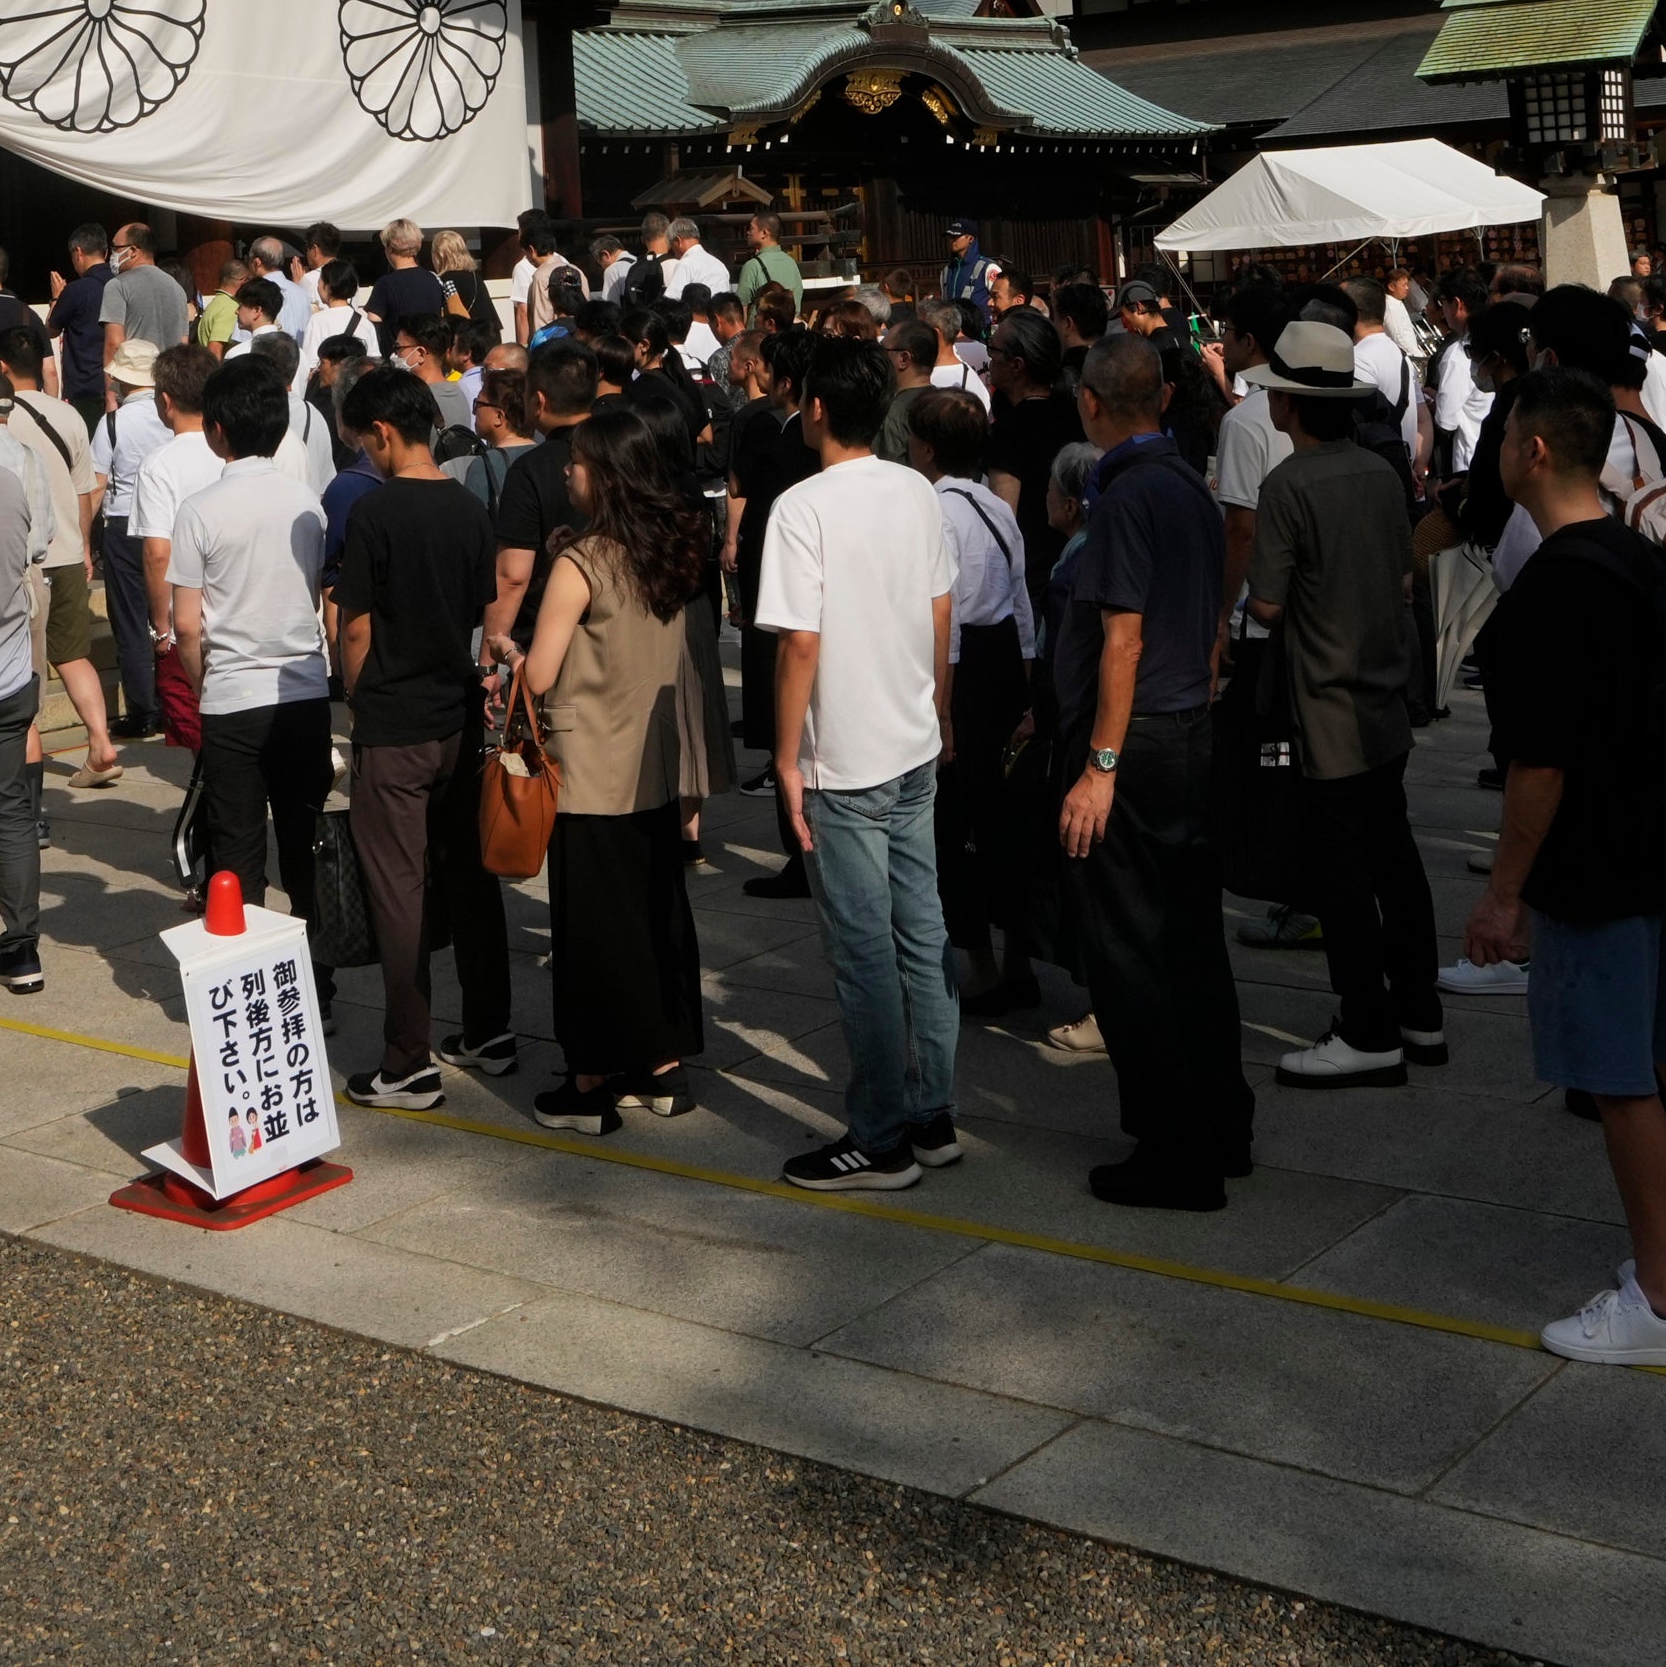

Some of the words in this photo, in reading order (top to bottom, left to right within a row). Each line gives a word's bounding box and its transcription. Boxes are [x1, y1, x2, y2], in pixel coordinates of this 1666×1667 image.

[208, 978, 251, 1101] び下さい。
[240, 968, 290, 1143] 列後方にお並
[272, 958, 320, 1127] 御参拝の方は
